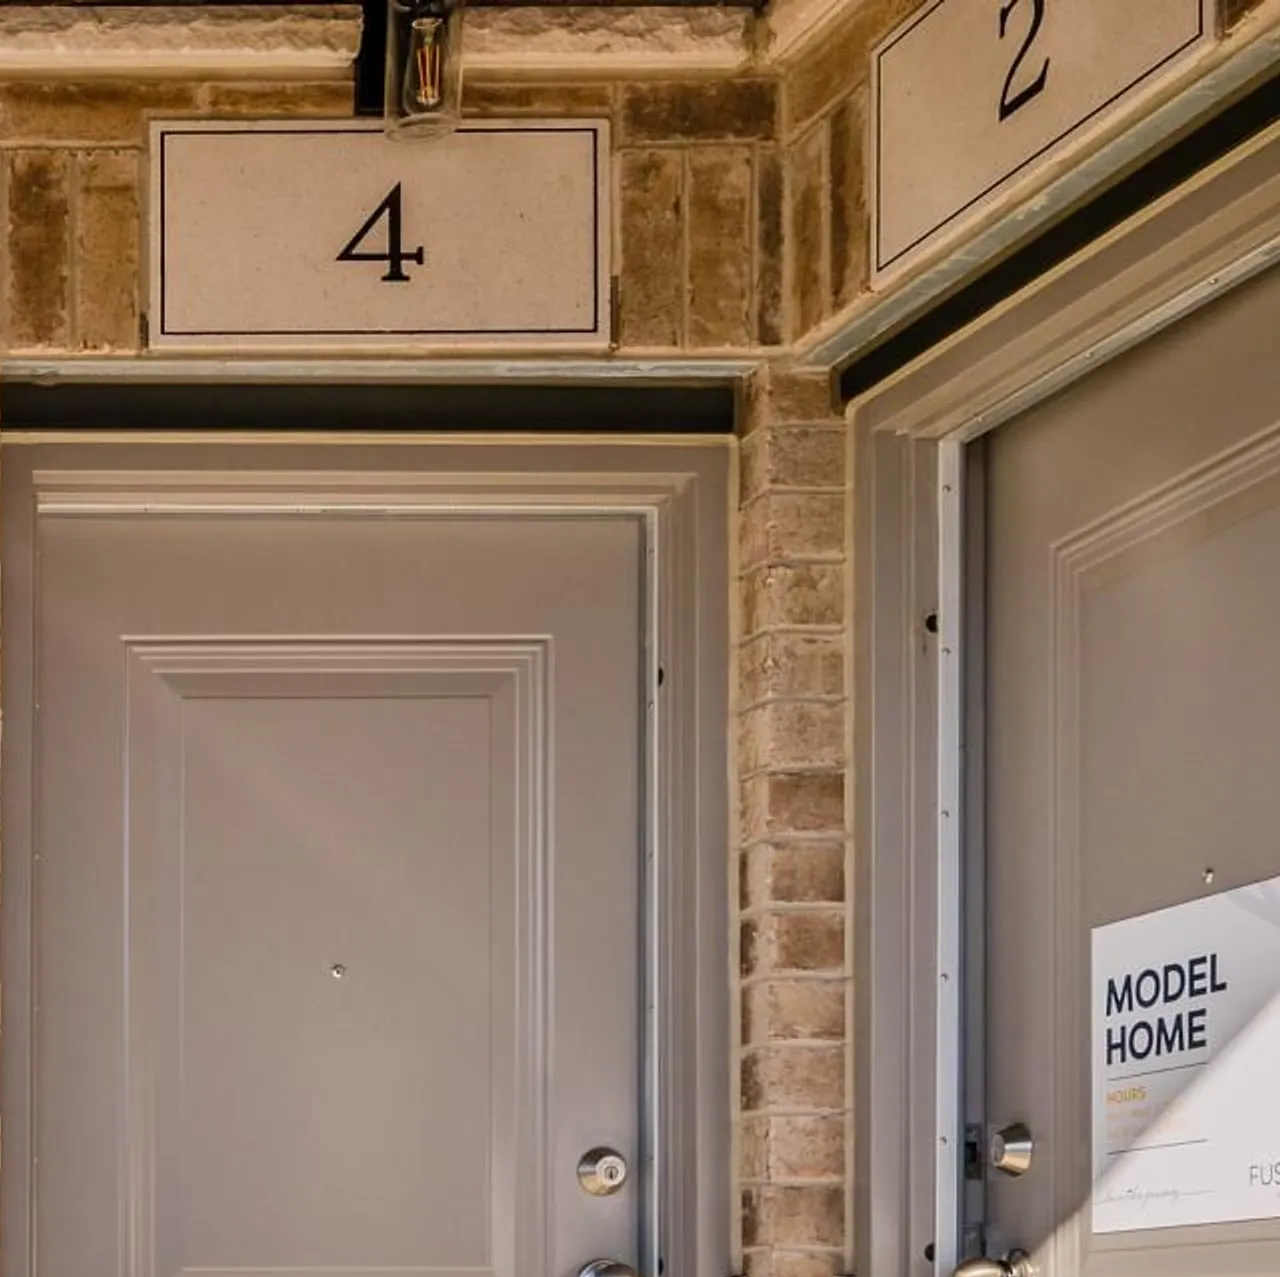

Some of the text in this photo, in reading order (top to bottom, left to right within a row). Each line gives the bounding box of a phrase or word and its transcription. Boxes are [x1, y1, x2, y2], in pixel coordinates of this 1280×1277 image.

[997, 0, 1051, 122] 2
[335, 181, 426, 283] 4
[1105, 953, 1227, 1017] MODEL
[1106, 1008, 1207, 1065] HOME
